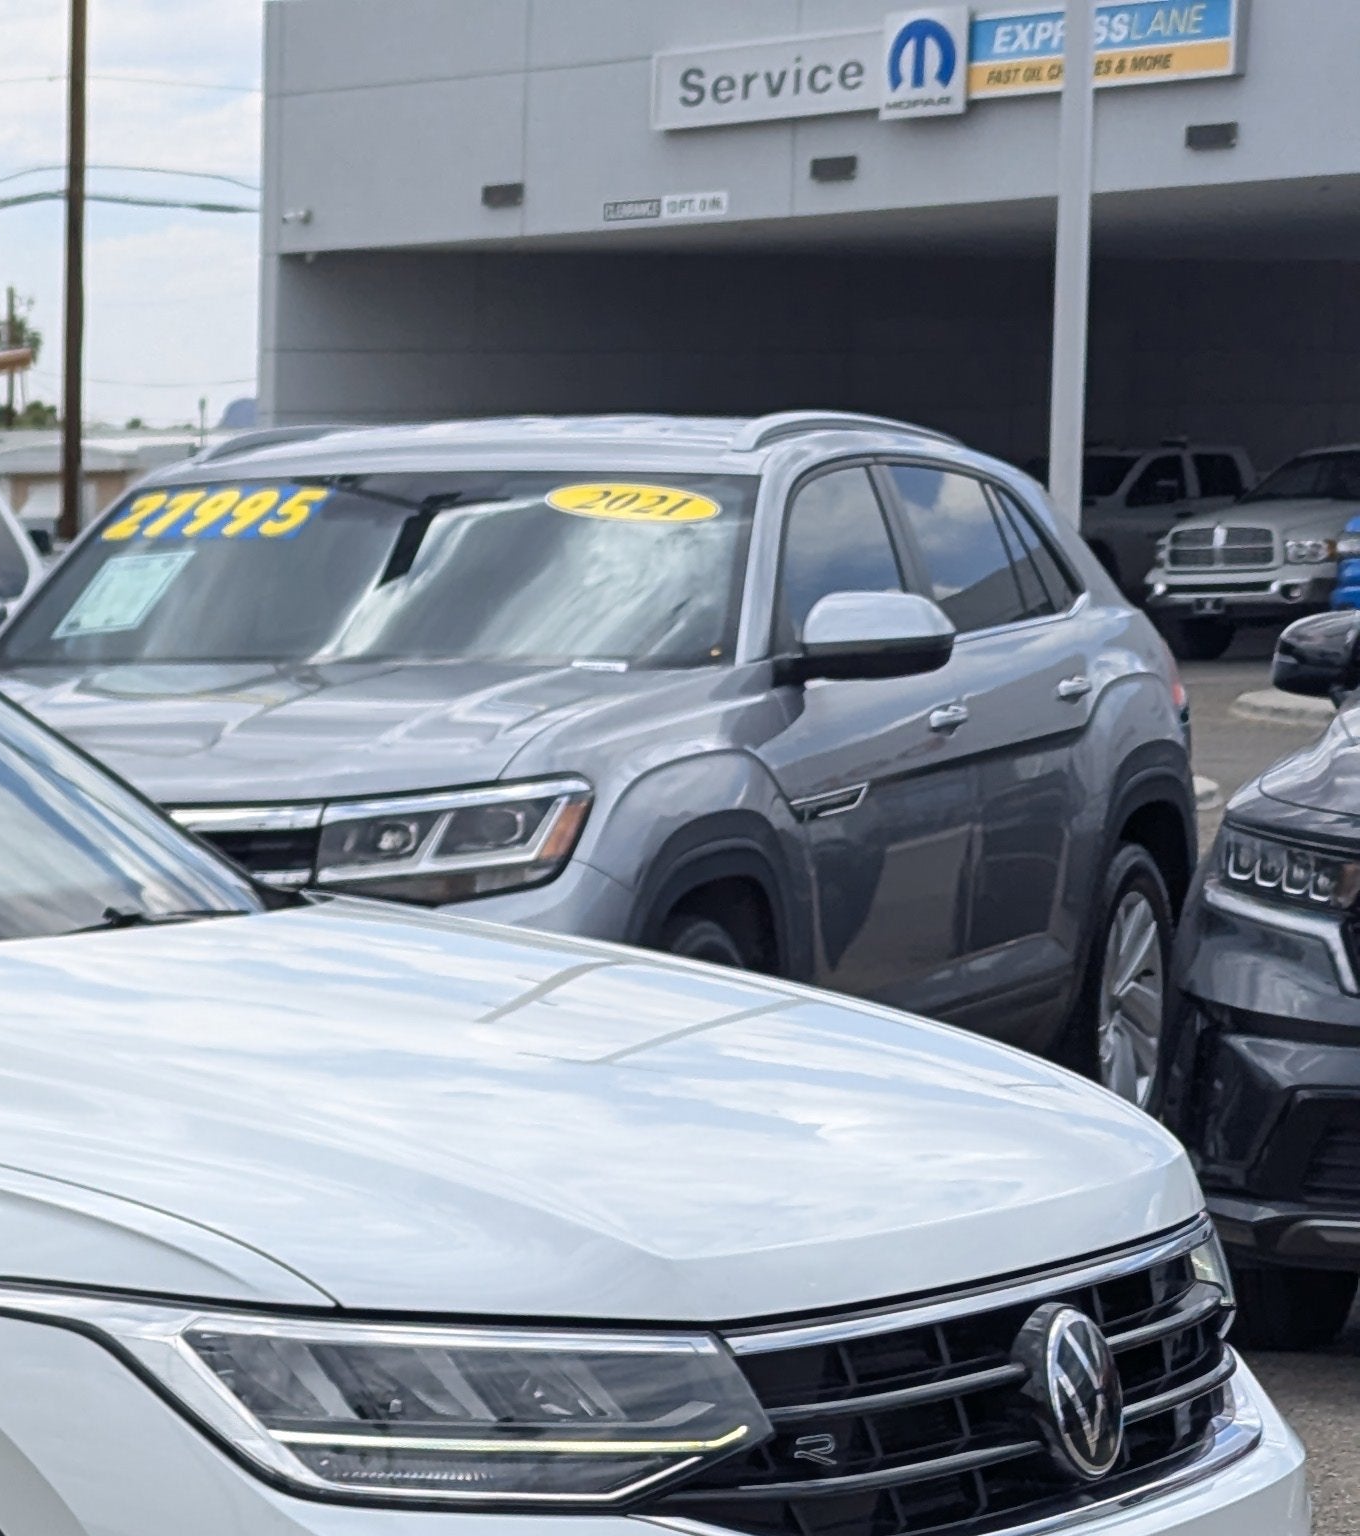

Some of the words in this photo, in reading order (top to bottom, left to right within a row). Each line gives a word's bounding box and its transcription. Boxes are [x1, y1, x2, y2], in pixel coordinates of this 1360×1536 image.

[679, 56, 864, 107] Service
[986, 68, 1020, 84] FAST
[1023, 66, 1041, 82] OIL
[1130, 53, 1173, 72] MORE
[101, 486, 328, 540] 27995
[574, 491, 695, 516] 2021
[794, 1433, 836, 1466] R
